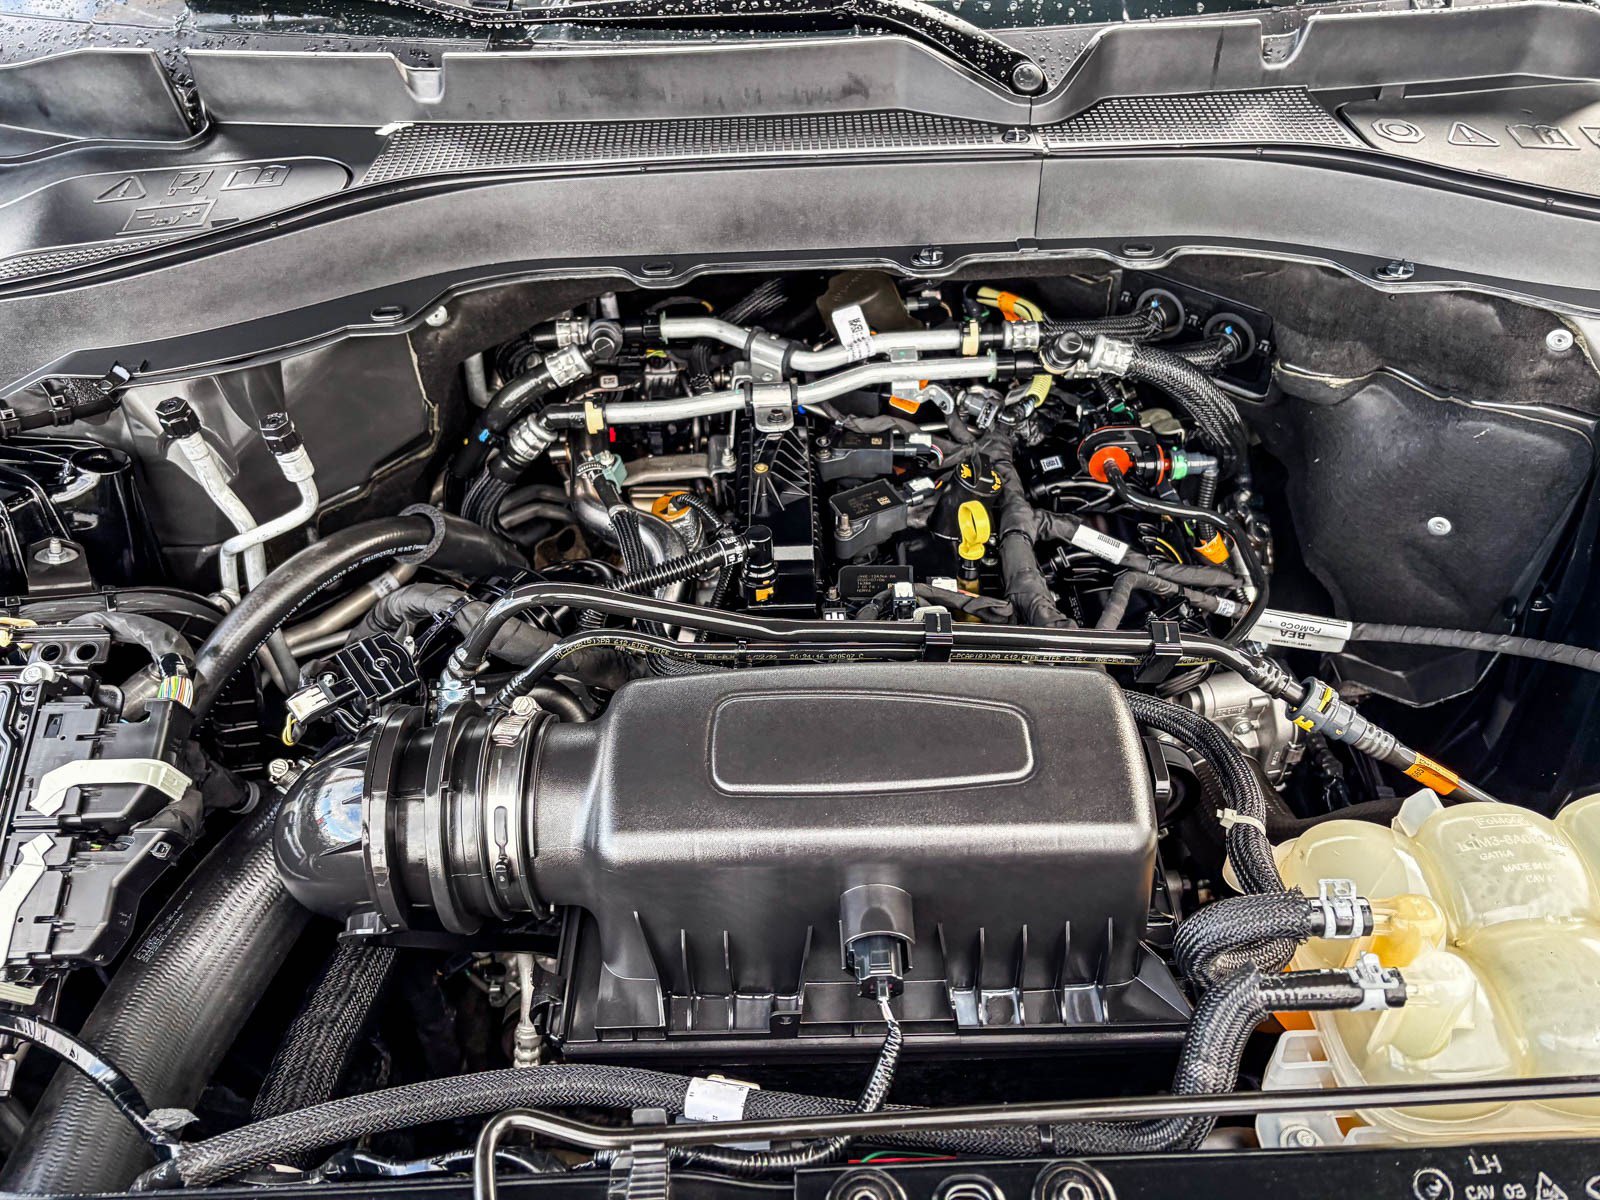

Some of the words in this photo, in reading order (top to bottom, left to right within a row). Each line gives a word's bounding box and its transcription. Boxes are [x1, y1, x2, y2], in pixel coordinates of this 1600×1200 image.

[317, 569, 348, 592] SUCTION
[1280, 621, 1322, 634] FoMoCo
[1280, 629, 1306, 640] BEA
[1477, 815, 1526, 826] FoMoC
[1502, 862, 1532, 873] MADE
[1468, 1154, 1502, 1175] LH
[1465, 1184, 1495, 1200] CAV
[1503, 1183, 1527, 1199] 03
